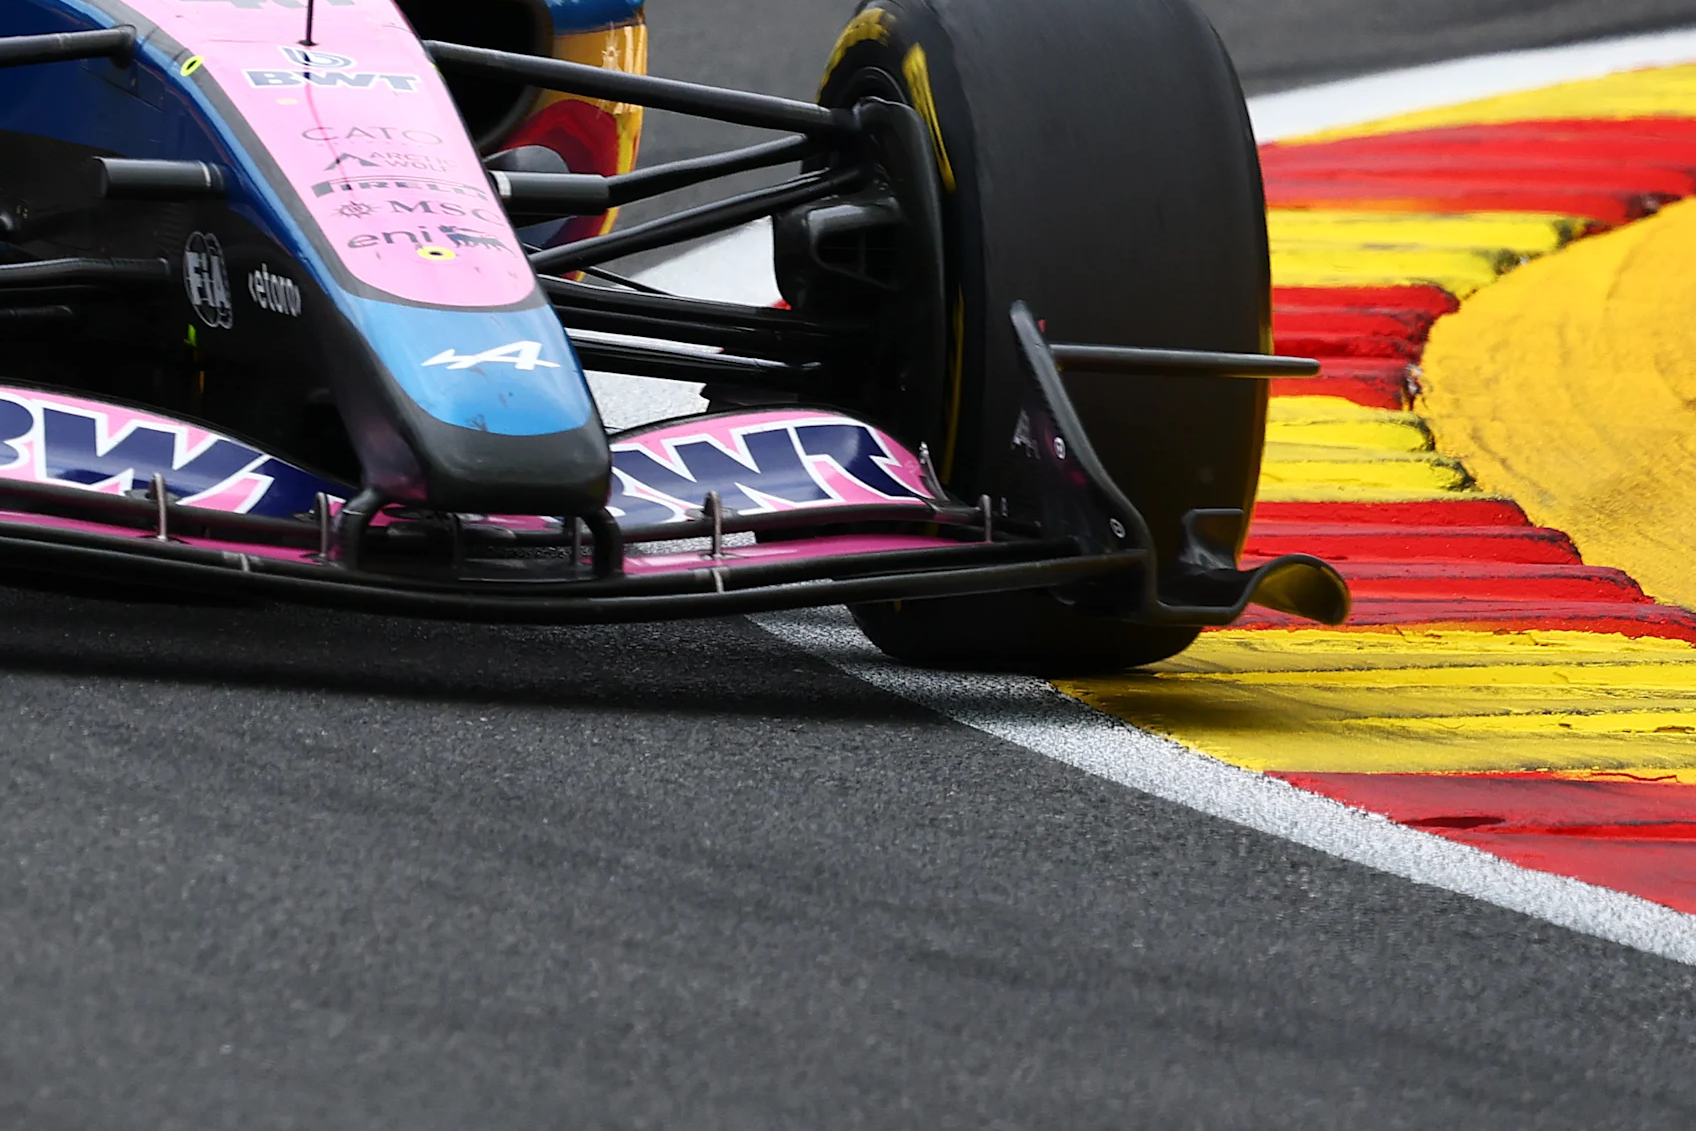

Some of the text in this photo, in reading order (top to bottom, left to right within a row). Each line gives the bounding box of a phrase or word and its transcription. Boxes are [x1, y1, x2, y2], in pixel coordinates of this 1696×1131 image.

[245, 69, 420, 92] BWT
[302, 126, 444, 145] CATO
[388, 200, 506, 226] MSC
[347, 225, 434, 249] eni
